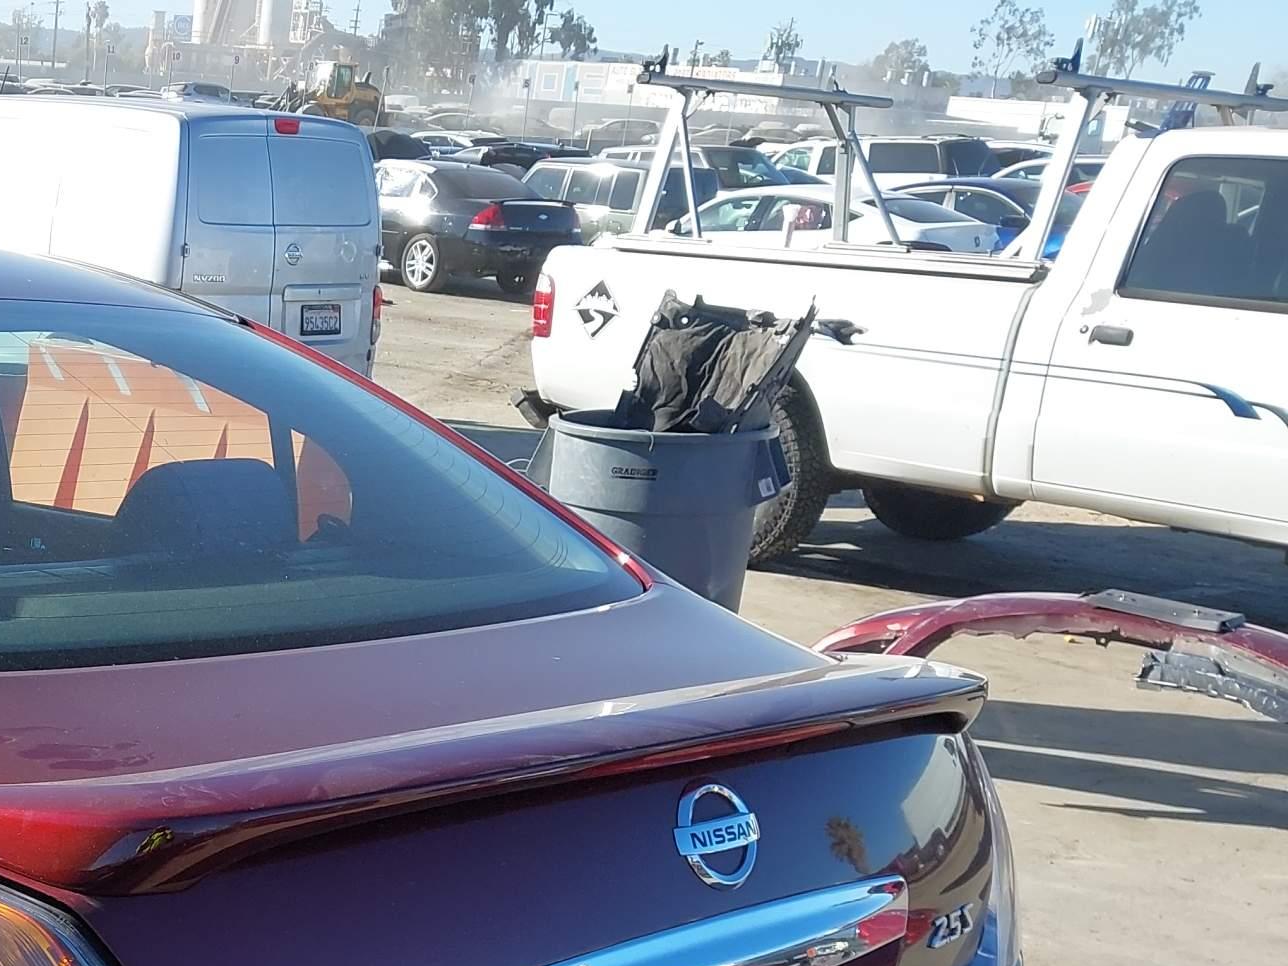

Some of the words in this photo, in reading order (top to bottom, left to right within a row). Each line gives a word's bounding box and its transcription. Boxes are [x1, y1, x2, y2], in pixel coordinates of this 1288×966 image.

[20, 37, 29, 45] 12
[172, 52, 181, 61] 10
[234, 55, 240, 64] 9
[193, 273, 226, 283] NV200
[690, 821, 757, 849] NISSAN
